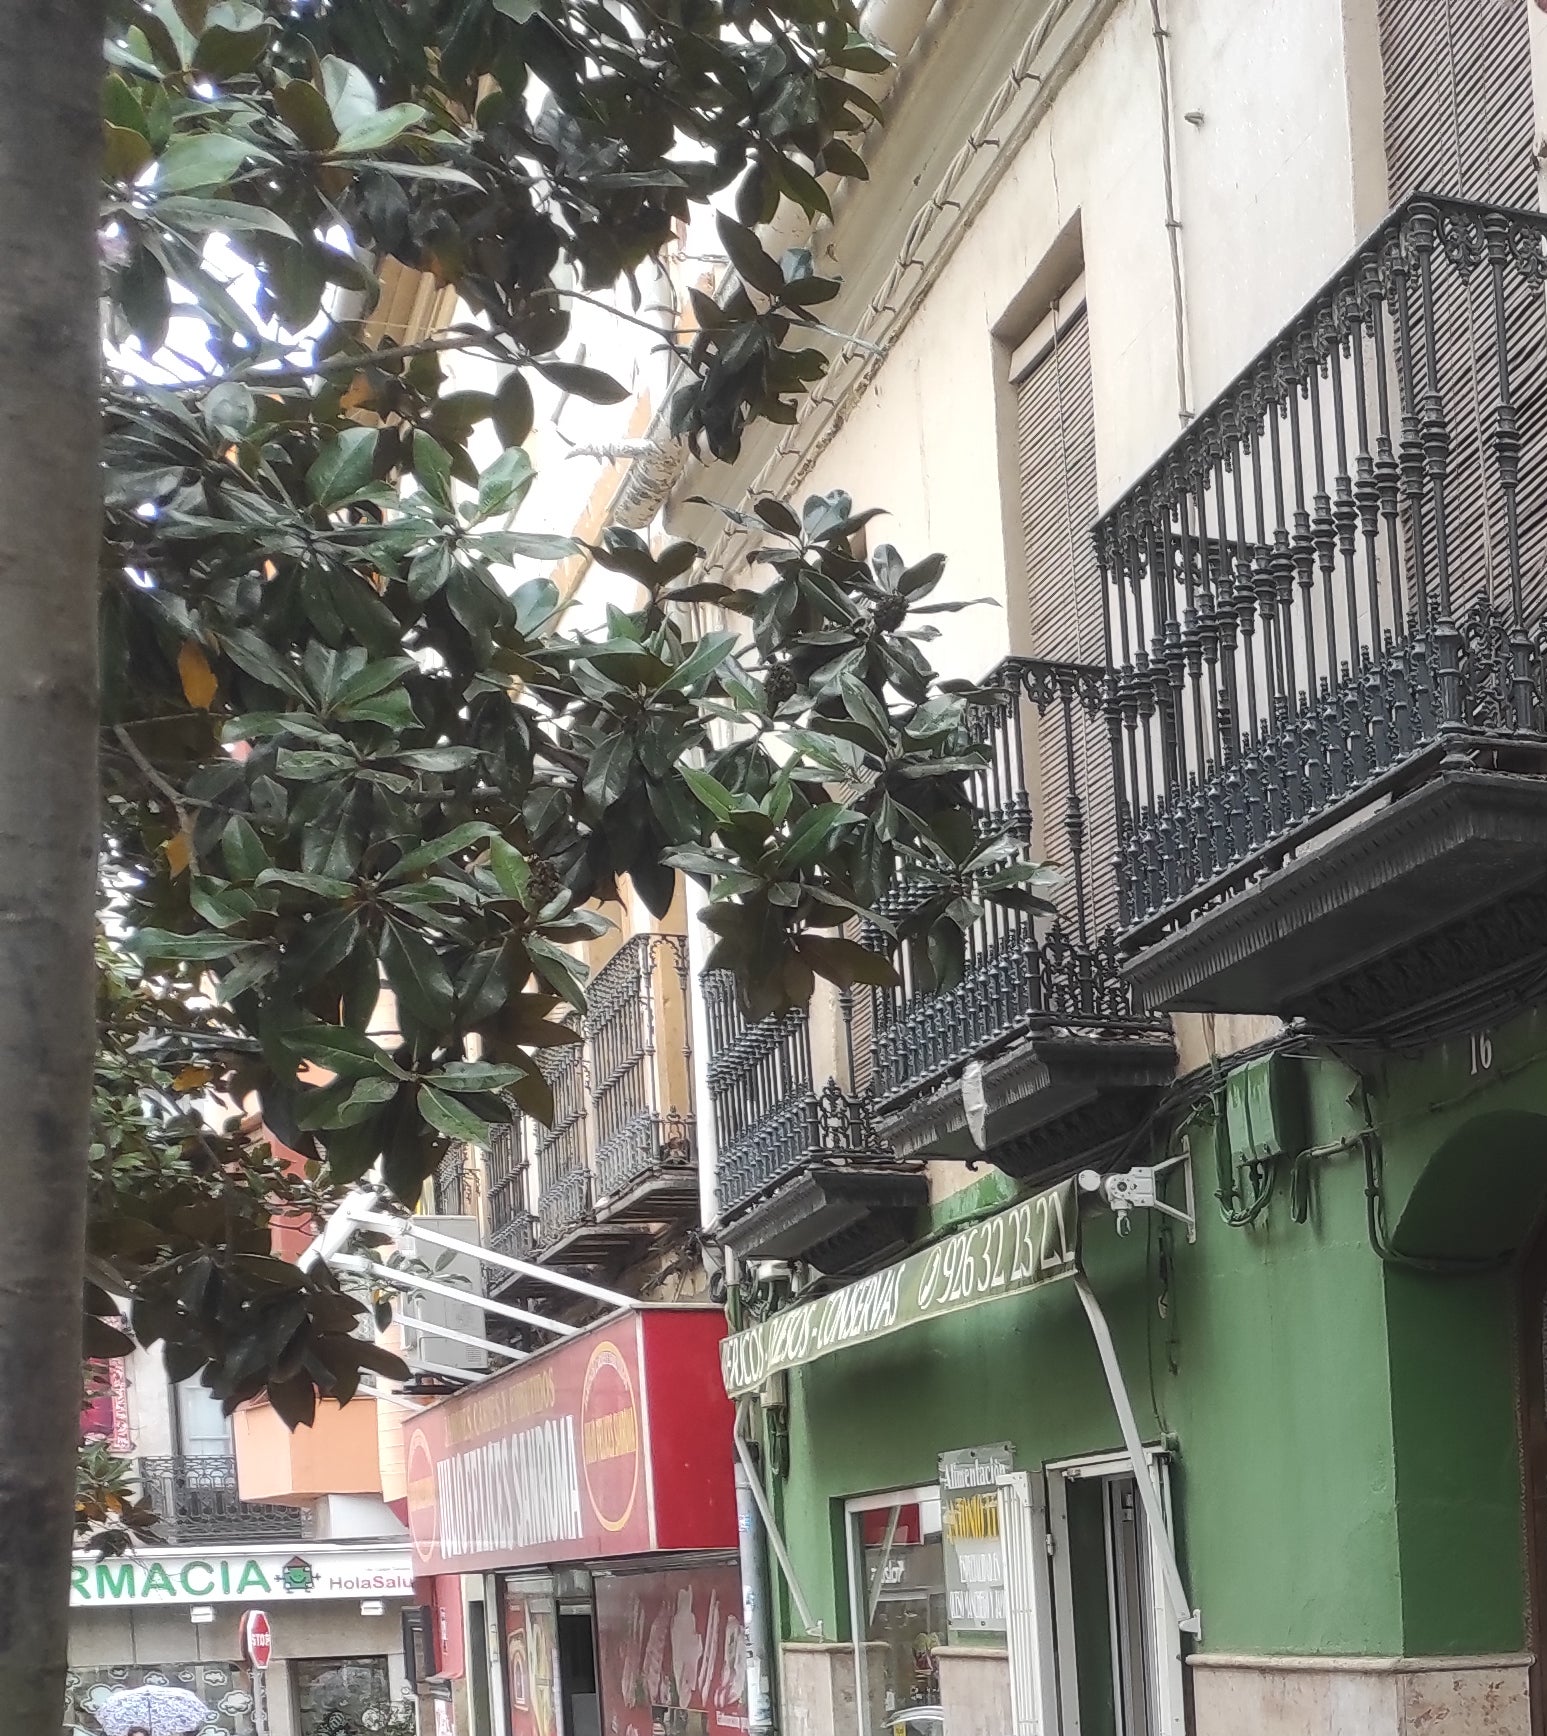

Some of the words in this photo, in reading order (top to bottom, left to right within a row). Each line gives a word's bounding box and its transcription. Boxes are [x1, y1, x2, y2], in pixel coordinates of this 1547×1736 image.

[937, 1227, 975, 1304] 926
[977, 1211, 1005, 1293] 32
[1010, 1206, 1033, 1283] 23
[816, 1264, 906, 1351] CONSERVAS
[433, 1453, 470, 1559] JULIO
[461, 1437, 515, 1553] FELICES
[507, 1412, 583, 1548] SANROMA
[71, 1559, 272, 1600] RMACIA
[329, 1575, 415, 1591] HolaSalu
[252, 1633, 270, 1648] STOP
